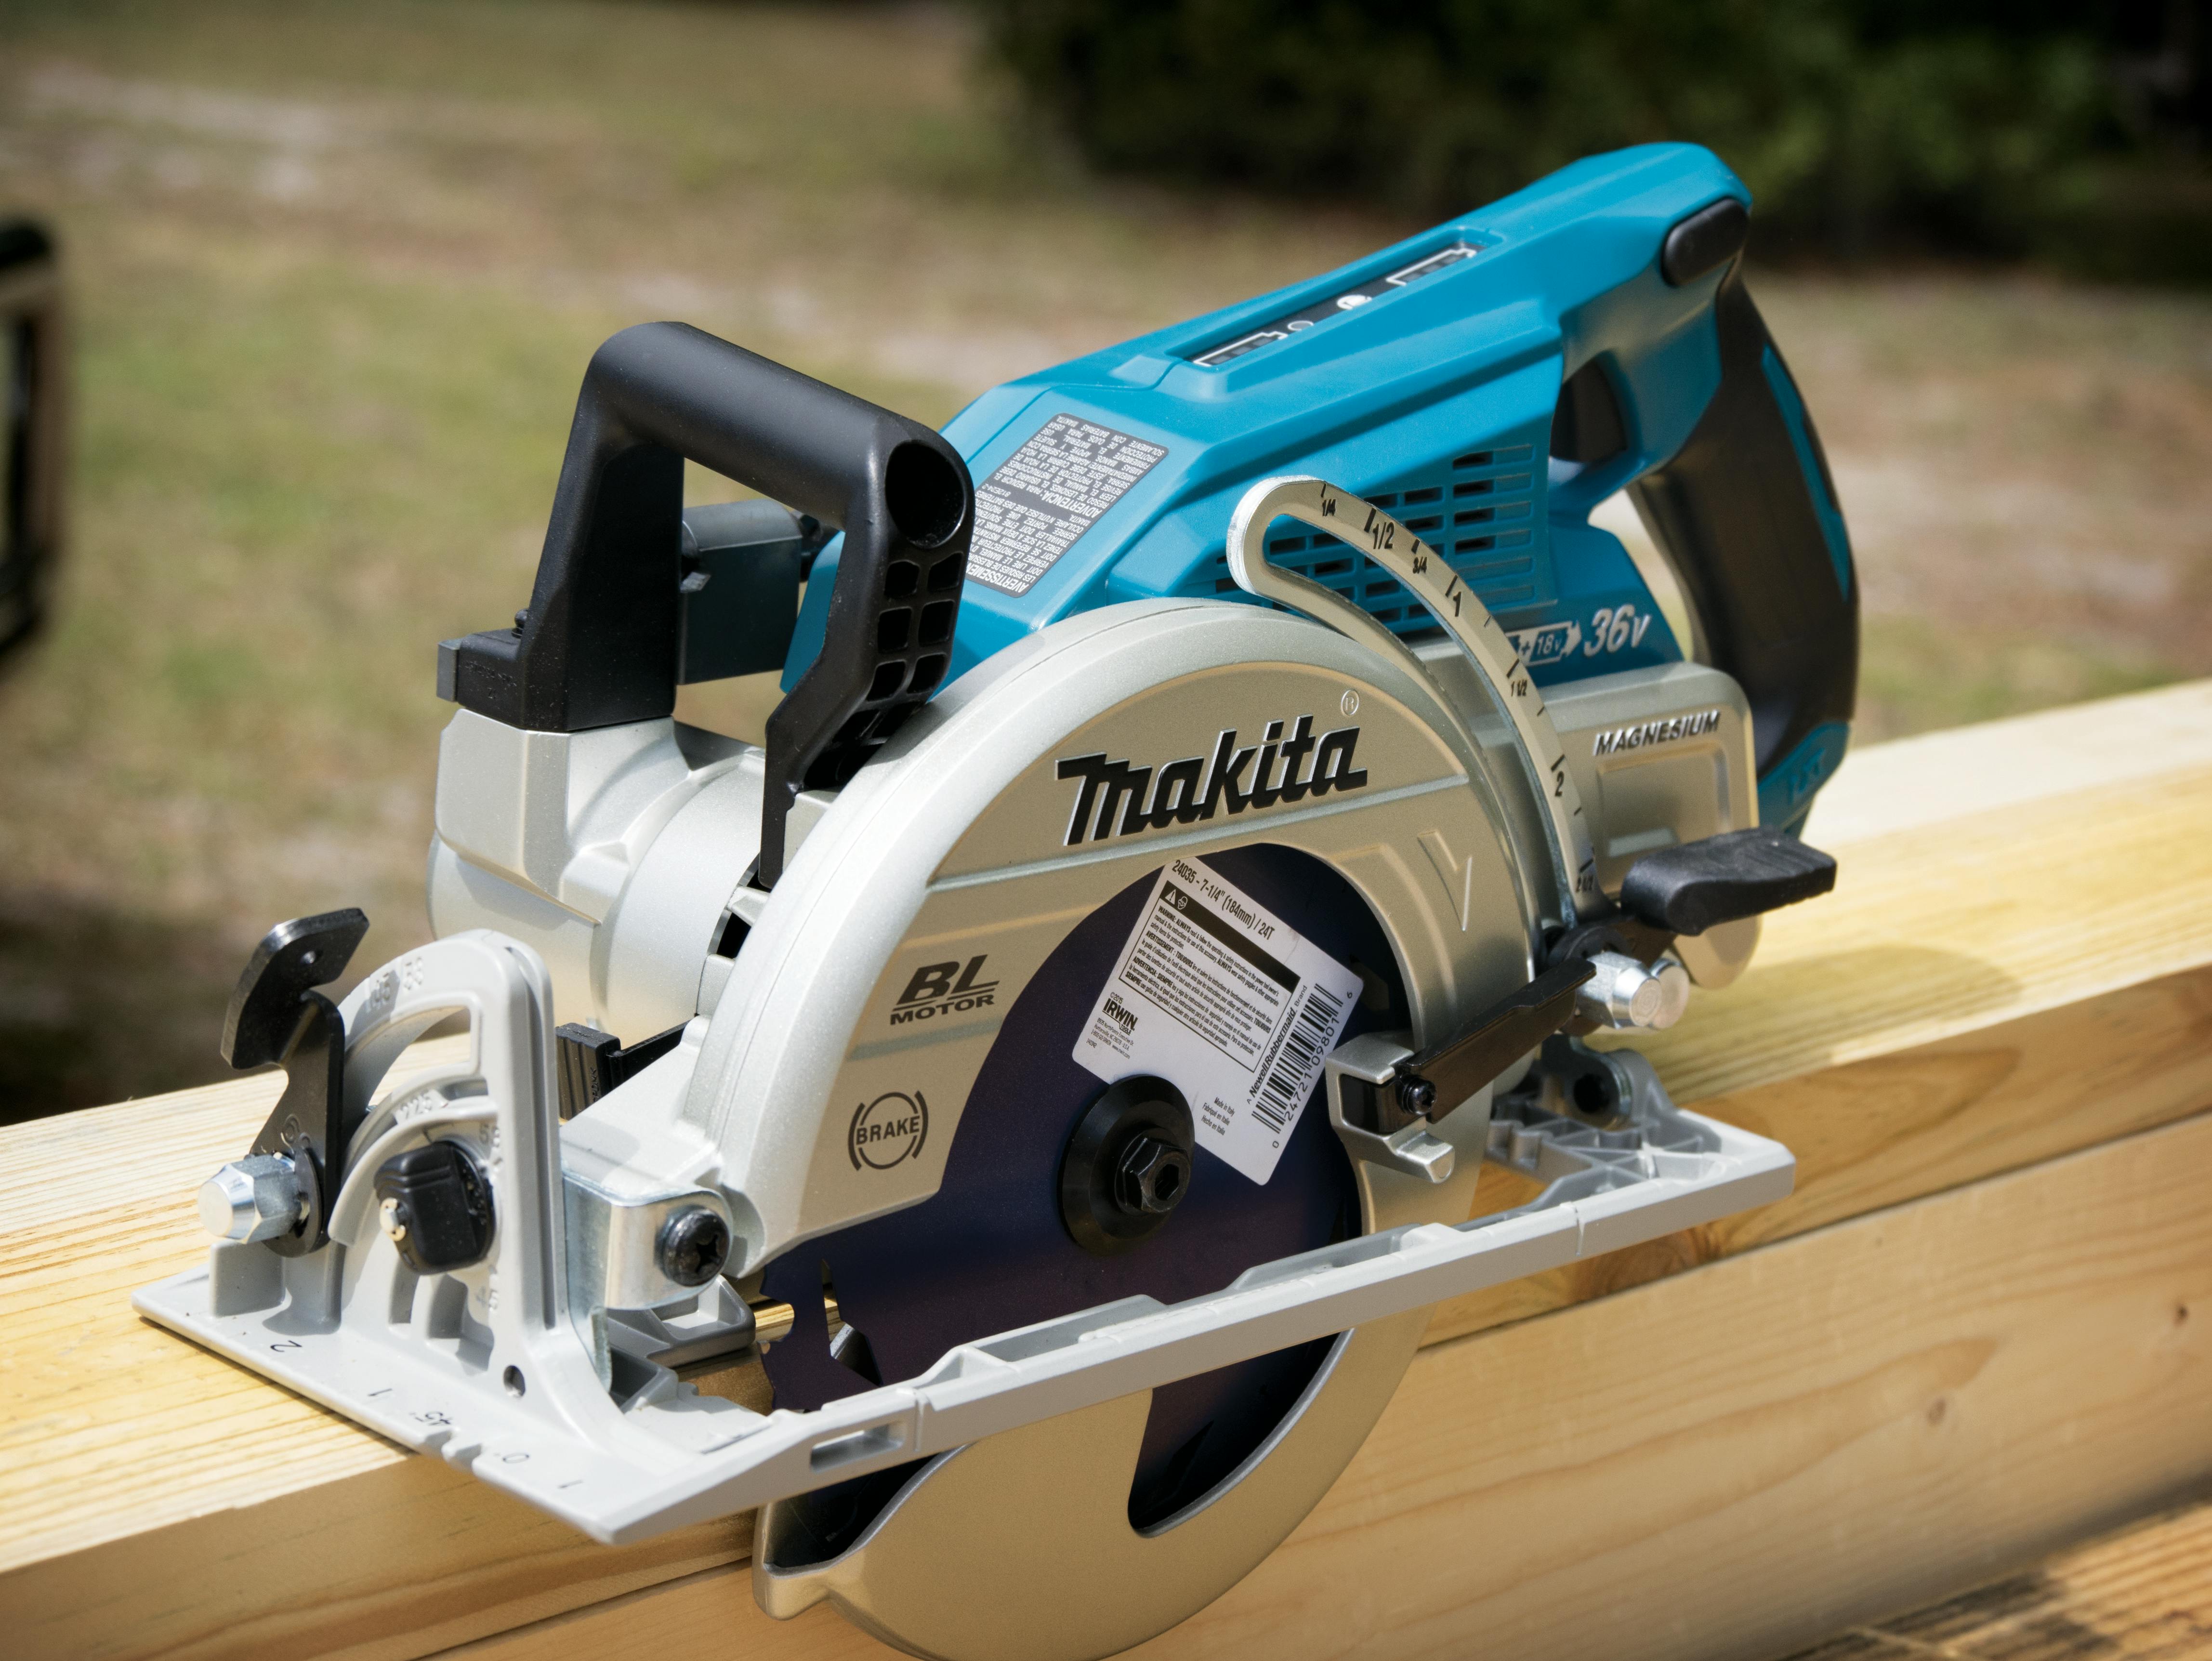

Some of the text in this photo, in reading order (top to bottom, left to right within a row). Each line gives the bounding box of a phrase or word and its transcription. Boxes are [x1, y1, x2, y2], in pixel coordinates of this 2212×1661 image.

[1040, 427, 1055, 436] USE
[1047, 421, 1066, 432] USAR
[1067, 428, 1087, 438] PARA
[1027, 440, 1041, 449] CON
[1033, 434, 1057, 446] SUJETE
[1106, 441, 1119, 449] DE
[1111, 435, 1127, 444] CON
[1020, 447, 1038, 457] HOJA
[1039, 444, 1061, 456] SIERRA
[1069, 446, 1092, 458] APOYE
[1098, 447, 1108, 455] EL
[1128, 440, 1165, 457] SOLAMENTE
[1037, 452, 1048, 461] LA
[1058, 451, 1069, 459] LA
[1065, 454, 1092, 467] AGARRE
[1112, 452, 1151, 470] FIRMEMENTE
[1047, 456, 1070, 468] CUBRIR
[999, 466, 1017, 476] DEBE
[1013, 453, 1124, 496] REVISE EL PROTECTOR DE LA HOJA DE
[1069, 464, 1088, 475] DEBE
[1121, 464, 1145, 476] AMBAS
[1015, 472, 1041, 485] USUARIO
[1040, 480, 1051, 488] EL
[1052, 475, 1064, 484] DE
[981, 483, 1012, 497] 812E24-2
[1064, 479, 1089, 493] MANUAL
[974, 490, 1005, 505] BATTERIES
[993, 472, 1103, 518] ADVERTENCIA: PARA REDUCIR EL
[1076, 493, 1088, 502] DE
[1090, 488, 1099, 497] EL
[1099, 492, 1117, 502] LEER
[1002, 500, 1017, 510] DES
[1013, 504, 1028, 514] QUE
[1086, 497, 1110, 509] RIESGO
[1321, 497, 1336, 516] 1/4
[1006, 511, 1021, 521] UNE
[1025, 508, 1056, 524] N'UTILISEZ
[974, 518, 986, 527] LA
[1023, 517, 1049, 530] PORTEZ
[1001, 527, 1020, 539] DEUX
[1018, 525, 1036, 535] DOIT
[1021, 535, 1038, 545] SCIE
[1035, 530, 1070, 548] TRAVAILLER
[1372, 523, 1394, 550] 1/2
[977, 538, 1016, 556] PROTECTEUR
[1000, 536, 1032, 553] REFERMER
[1035, 540, 1046, 548] LA
[1043, 543, 1063, 555] TENEZ
[979, 547, 1004, 562] MANUEL
[1014, 551, 1025, 560] LE
[1030, 548, 1042, 556] SE
[1040, 552, 1057, 562] DOIT
[990, 562, 1002, 571] DE
[1002, 556, 1014, 565] LE
[1012, 560, 1028, 570] LIRE
[1412, 556, 1427, 575] 3/4
[999, 565, 1026, 579] RISQUES
[1026, 566, 1043, 576] DOIT
[965, 562, 1029, 593] AVERTISSEMEN
[1022, 574, 1036, 583] LES
[1453, 591, 1463, 617] 1
[1593, 711, 1721, 756] MAGNESIUM
[1555, 771, 1564, 797] 2
[1172, 859, 1197, 884] 24035
[1222, 895, 1256, 929] (184mm)
[1257, 922, 1276, 940] 24T
[1175, 918, 1191, 933] ALWAYS
[1145, 930, 1194, 968] AVERTISSEMENT TOUJOURS
[1216, 958, 1233, 973] ALWAYS
[896, 954, 1000, 1005] BL
[1125, 971, 1142, 987] SIEMPRE
[1157, 973, 1174, 988] SIEMPRE
[1294, 985, 1307, 1007] Brand
[890, 994, 995, 1026] MOTOR
[1119, 1024, 1132, 1035] TOOLS
[1253, 1017, 1271, 1034] TOUJOURS
[1272, 1140, 1279, 1149] 0
[1283, 1071, 1313, 1122] 24721
[1310, 1016, 1340, 1067] 09801
[1213, 1096, 1224, 1108] Made
[1226, 1106, 1235, 1117] Italy
[1202, 1102, 1218, 1117] Fabriqué
[1221, 1115, 1230, 1126] Italie
[856, 1116, 921, 1146] BRAKE
[1201, 1114, 1212, 1127] Hecho
[1216, 1125, 1225, 1136] Italia
[270, 1340, 303, 1353] 2
